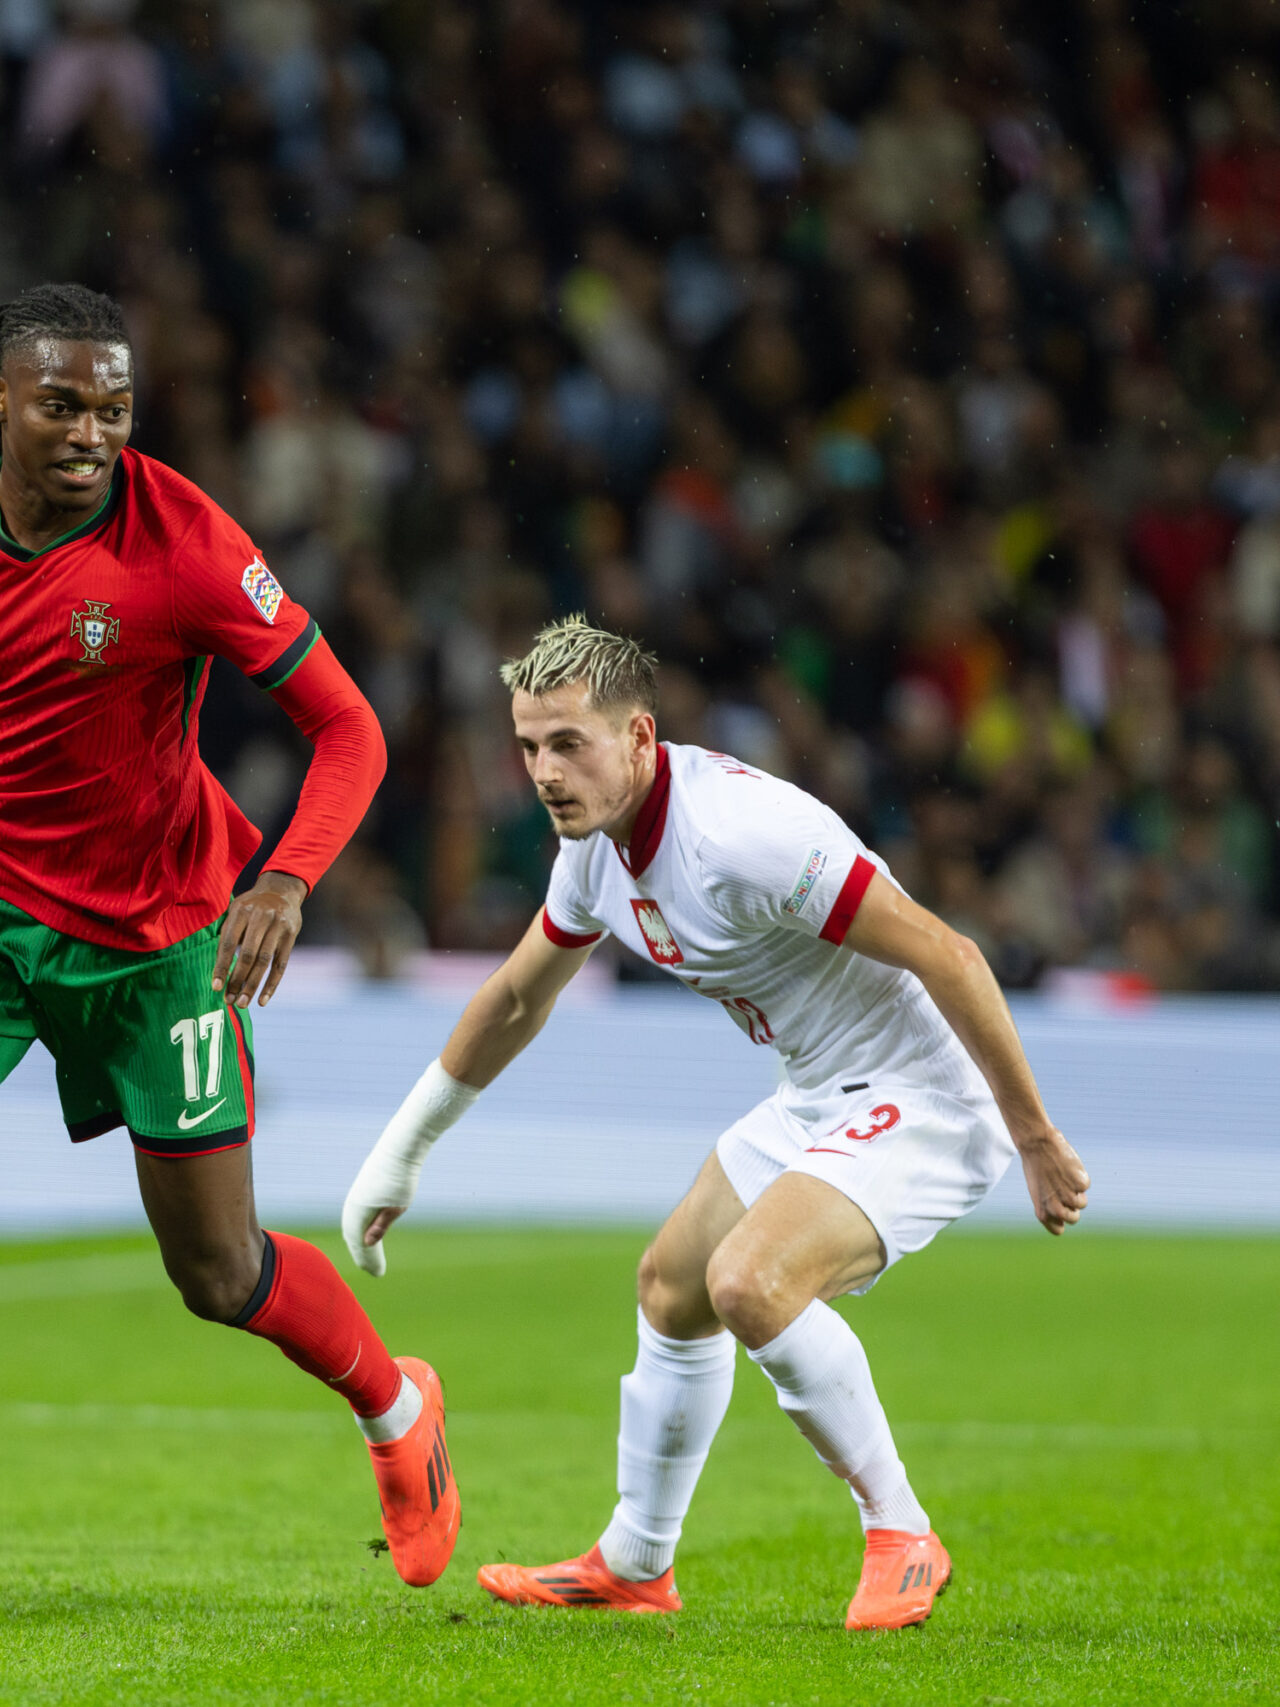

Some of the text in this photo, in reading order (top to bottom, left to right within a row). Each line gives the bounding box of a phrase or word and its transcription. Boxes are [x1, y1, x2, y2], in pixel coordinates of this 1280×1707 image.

[787, 849, 822, 915] FOUNDATION
[170, 1009, 224, 1102] 17
[826, 1103, 901, 1144] 3
